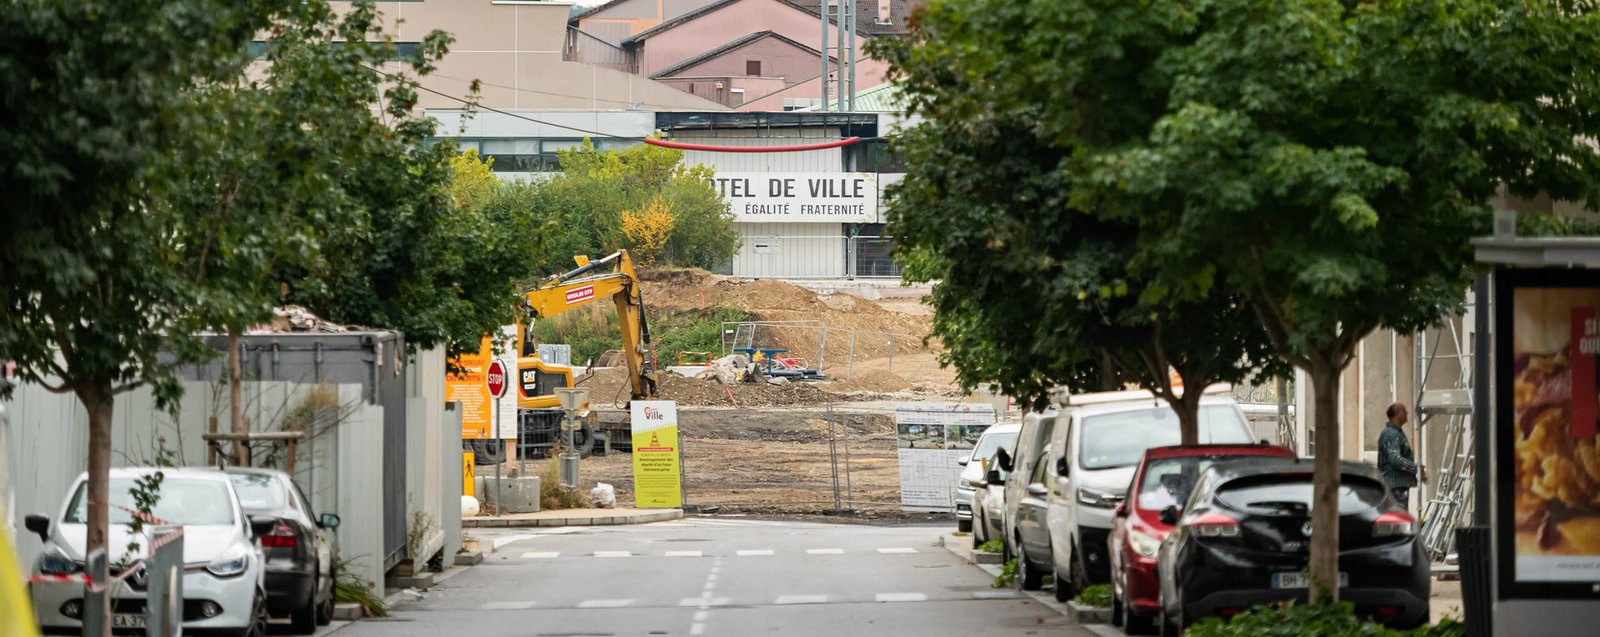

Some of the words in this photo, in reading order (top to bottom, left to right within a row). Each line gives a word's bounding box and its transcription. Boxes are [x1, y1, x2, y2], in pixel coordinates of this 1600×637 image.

[768, 178, 795, 198] DE
[808, 178, 865, 198] VILLE
[745, 202, 790, 215] ÉGALITÉ
[801, 202, 865, 215] FRATERNITÉ
[488, 373, 502, 385] STOP
[523, 370, 536, 383] CAT
